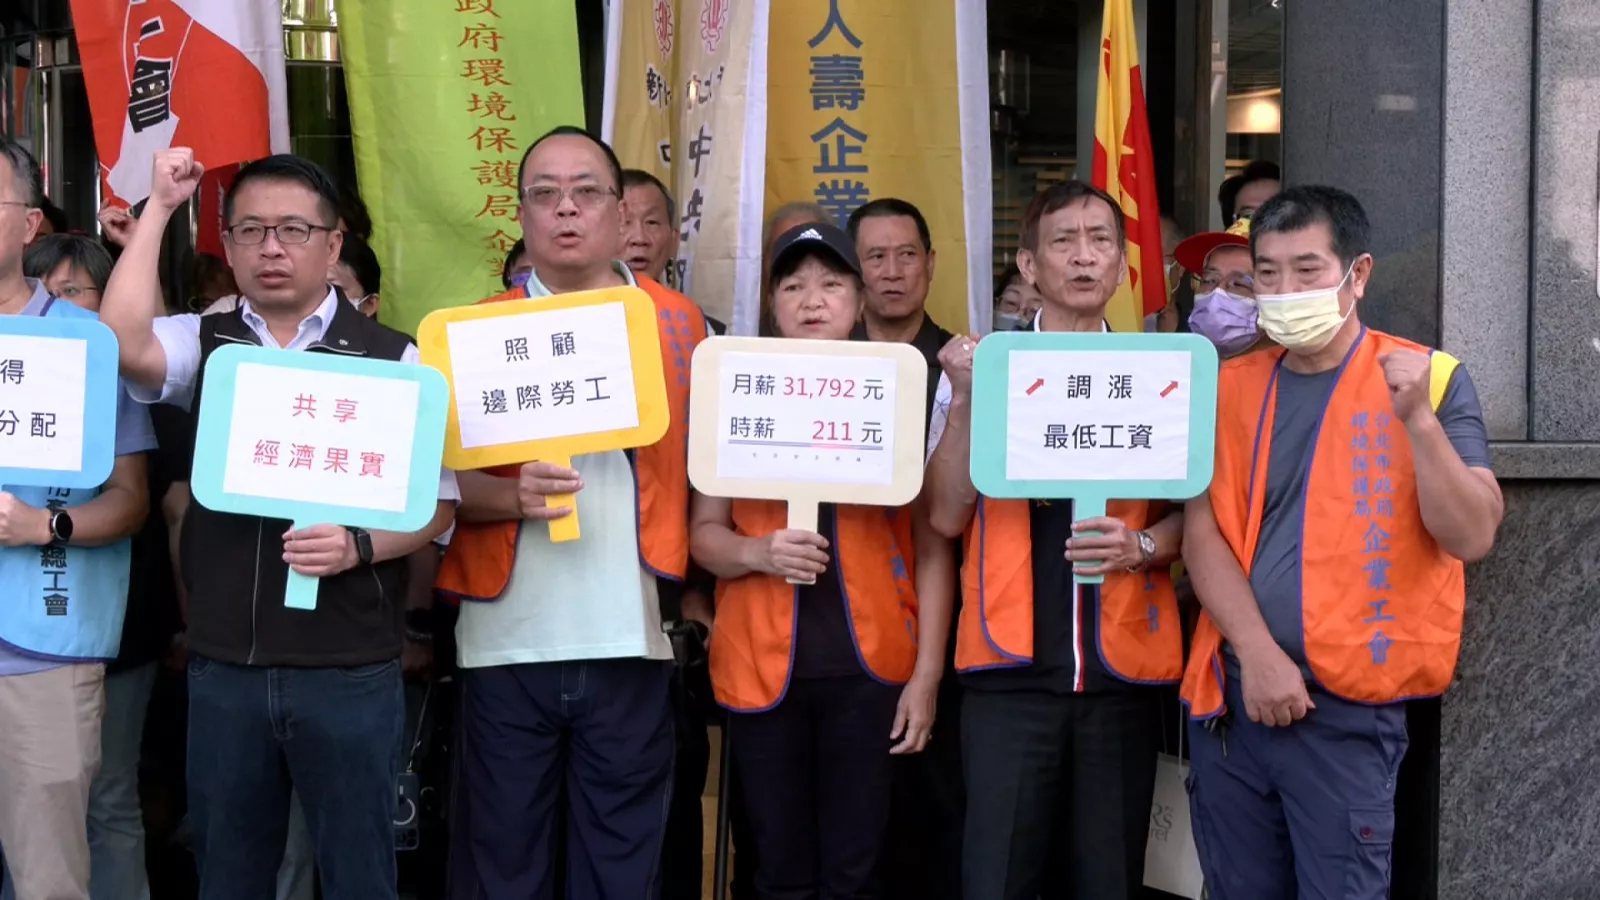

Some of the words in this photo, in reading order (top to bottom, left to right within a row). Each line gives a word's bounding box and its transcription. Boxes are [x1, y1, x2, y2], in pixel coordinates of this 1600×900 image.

[454, 0, 521, 292] 政府環境保護局企
[505, 331, 577, 363] 照顧
[0, 359, 25, 385] 得
[481, 376, 611, 415] 邊際勞工
[732, 373, 776, 396] 月薪
[783, 376, 856, 399] 31,792
[862, 379, 884, 401] 元
[1067, 374, 1133, 400] 調漲
[292, 393, 359, 423] 共享
[0, 410, 57, 438] 分配
[730, 415, 776, 439] 時薪
[811, 420, 853, 441] 211
[860, 421, 883, 444] 元
[1043, 424, 1153, 450] 最低工資
[252, 439, 385, 479] 經濟果實
[1360, 521, 1396, 664] 企業工會
